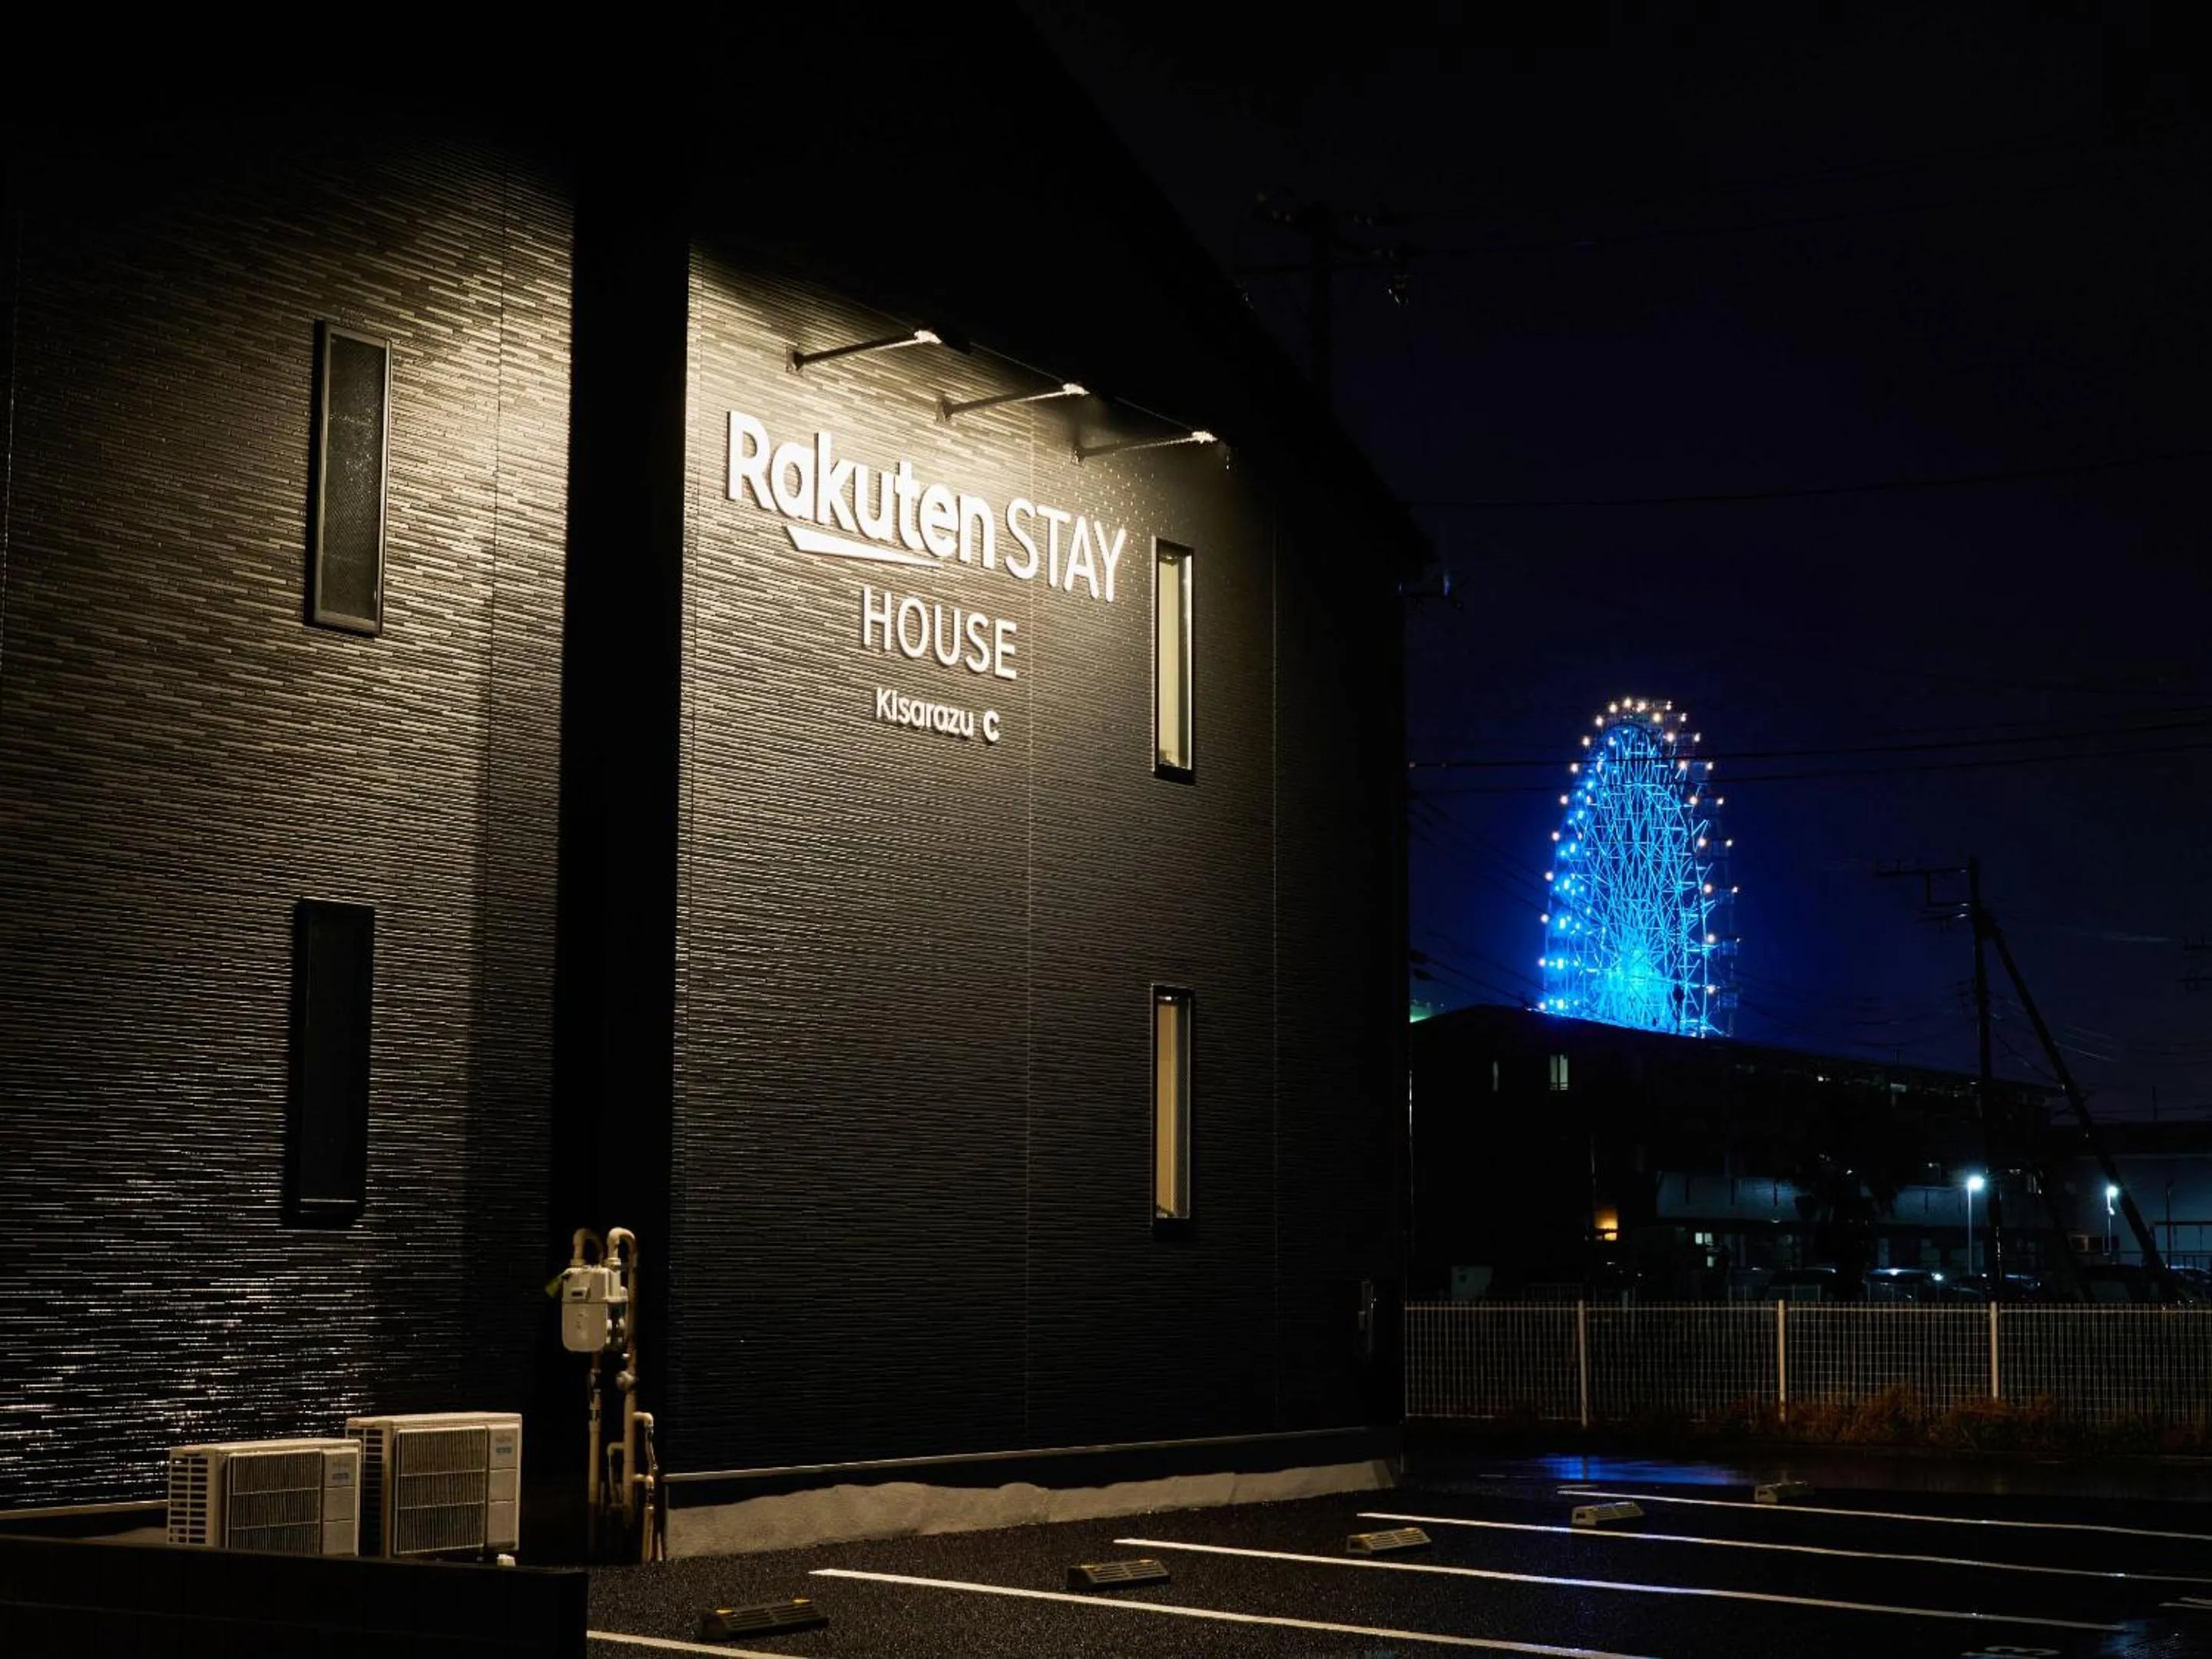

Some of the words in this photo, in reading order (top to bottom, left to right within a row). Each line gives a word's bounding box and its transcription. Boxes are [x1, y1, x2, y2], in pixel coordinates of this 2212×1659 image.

[727, 411, 996, 570] Rakuten
[1005, 498, 1127, 603] STAY
[862, 586, 1018, 680] HOUSE
[876, 687, 974, 737] Kisarazu
